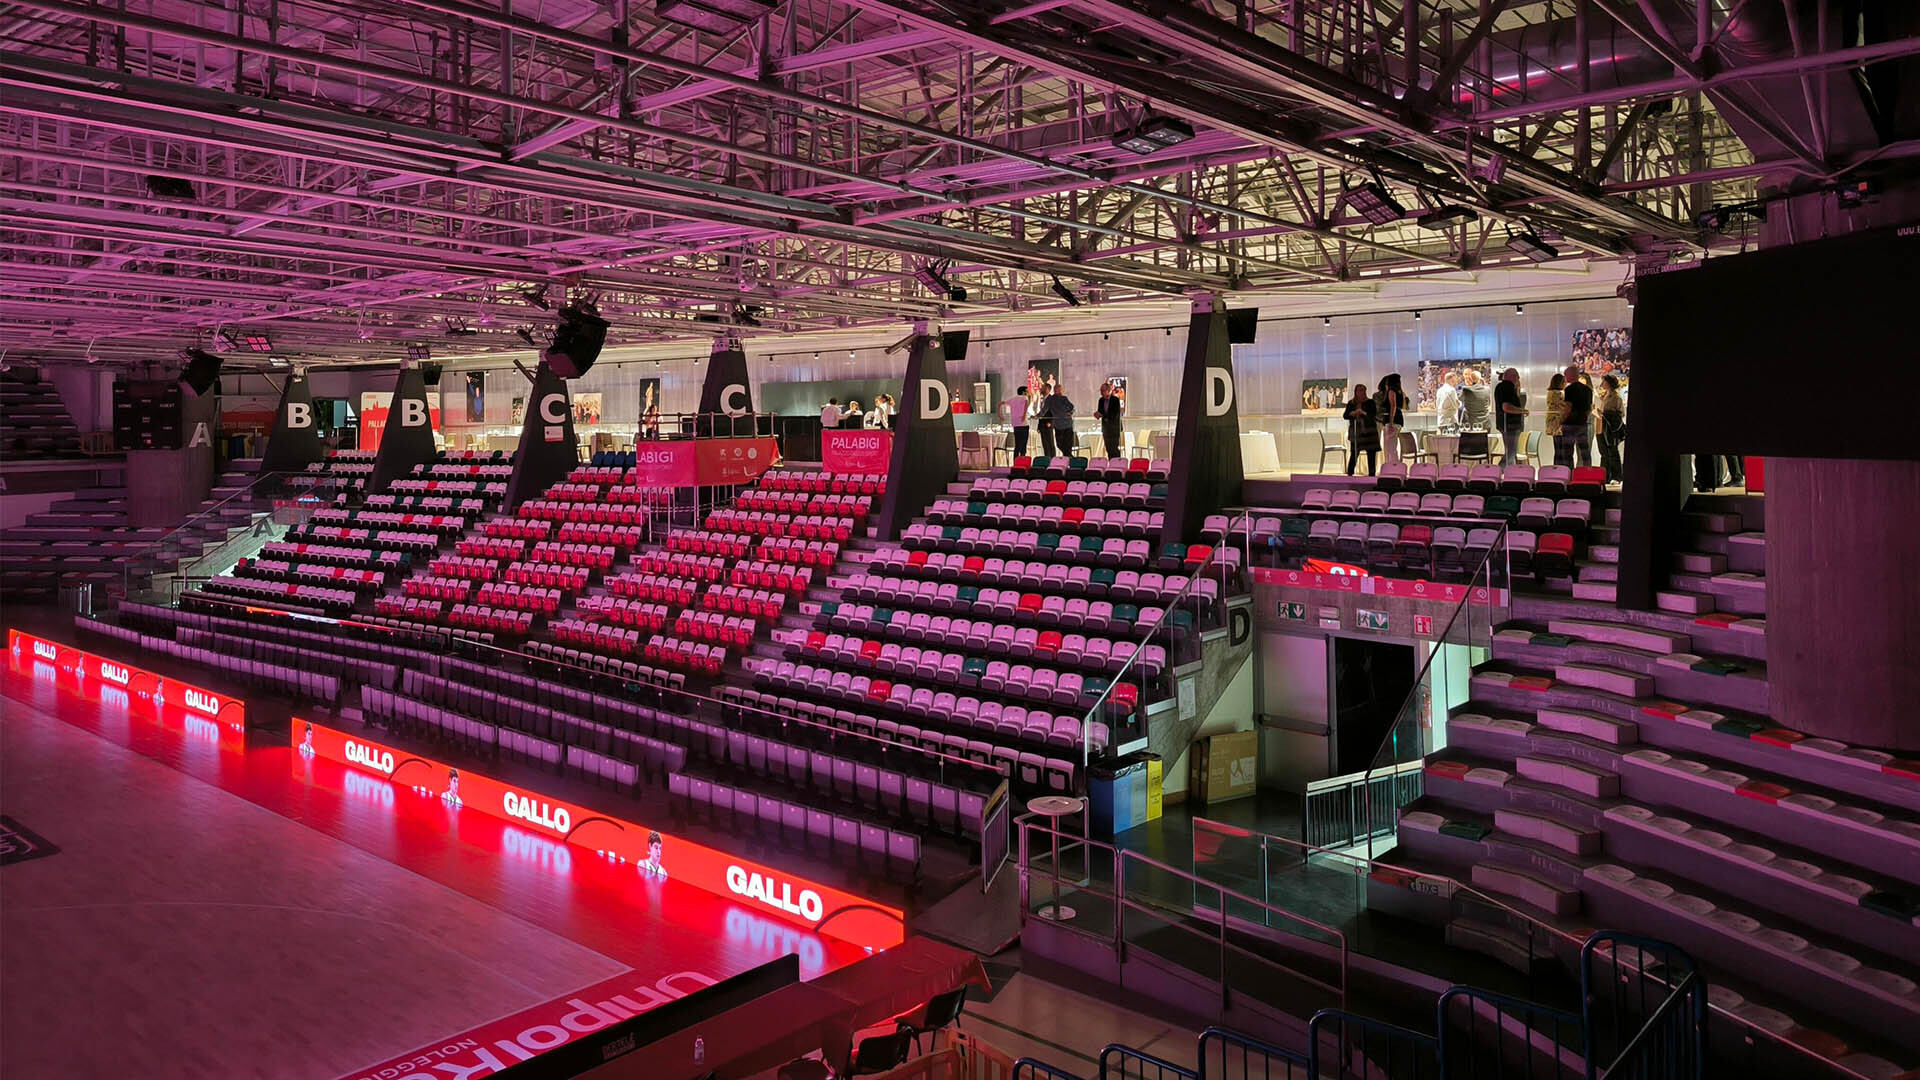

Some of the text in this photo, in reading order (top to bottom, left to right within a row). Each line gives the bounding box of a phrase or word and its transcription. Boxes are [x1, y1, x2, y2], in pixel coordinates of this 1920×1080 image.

[719, 384, 747, 418] C
[920, 378, 949, 420] D
[1206, 367, 1233, 416] D
[287, 402, 312, 429] B
[401, 398, 427, 427] B
[540, 393, 566, 424] C
[189, 422, 212, 448] A
[830, 437, 880, 449] PALABIGI
[252, 518, 275, 538] A
[1229, 606, 1251, 648] D
[33, 641, 56, 660] GALLO
[101, 662, 129, 685] GALLO
[185, 689, 219, 715] GALLO
[344, 740, 394, 774] GALLO
[503, 791, 570, 833] GALLO
[726, 865, 823, 921] GALLO
